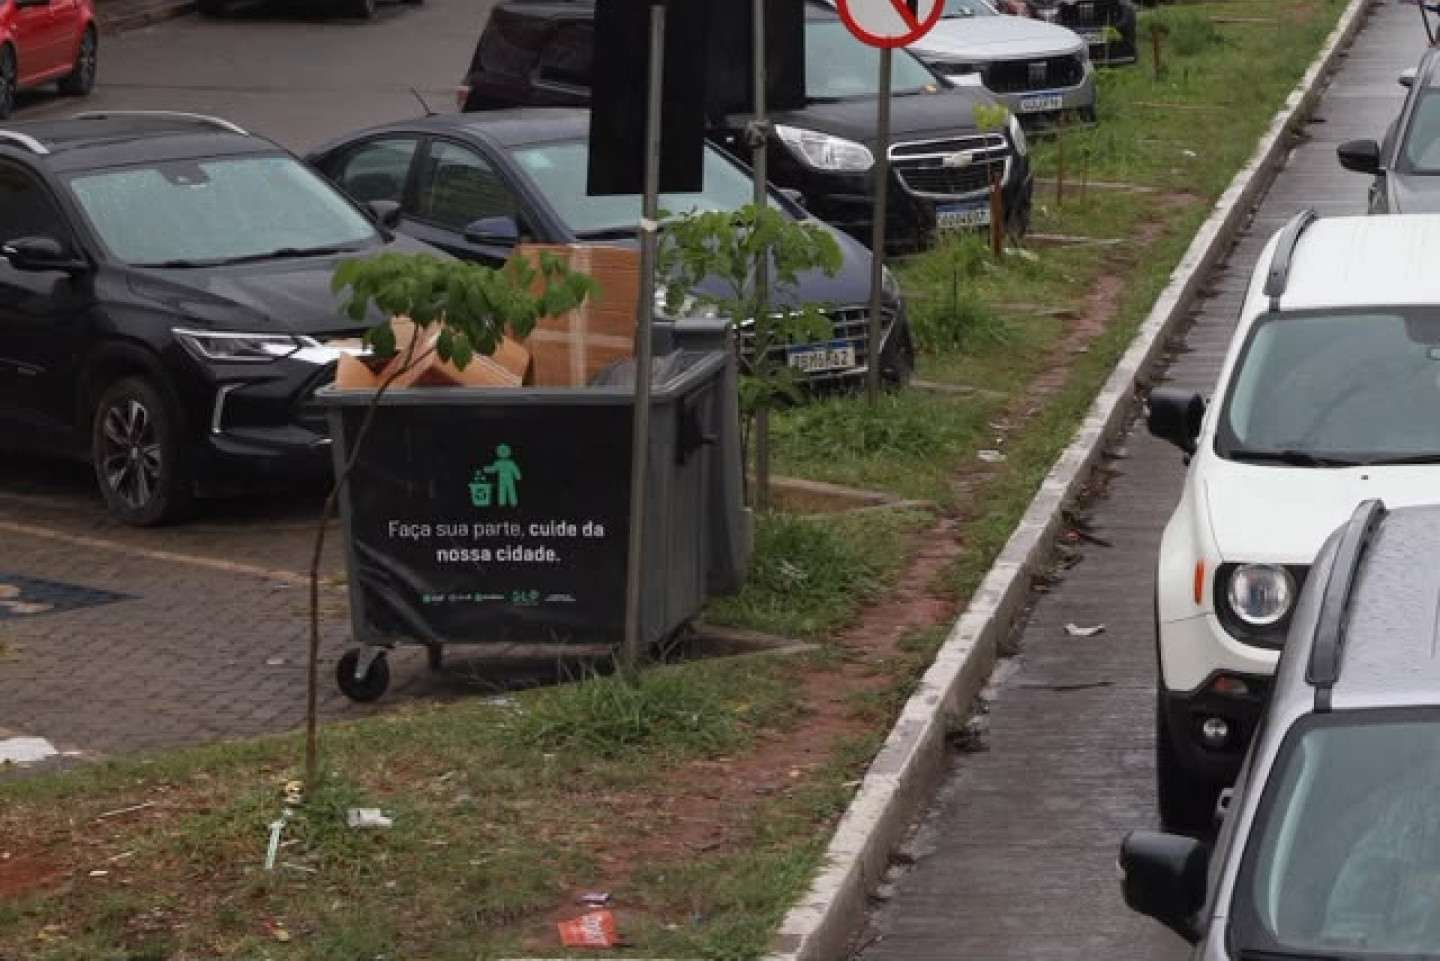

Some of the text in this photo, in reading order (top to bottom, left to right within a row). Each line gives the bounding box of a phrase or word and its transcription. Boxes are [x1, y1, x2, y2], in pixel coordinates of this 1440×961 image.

[388, 520, 431, 540] Faça
[436, 524, 469, 537] sua
[582, 520, 605, 538] da
[436, 544, 561, 562] nossa cidade.
